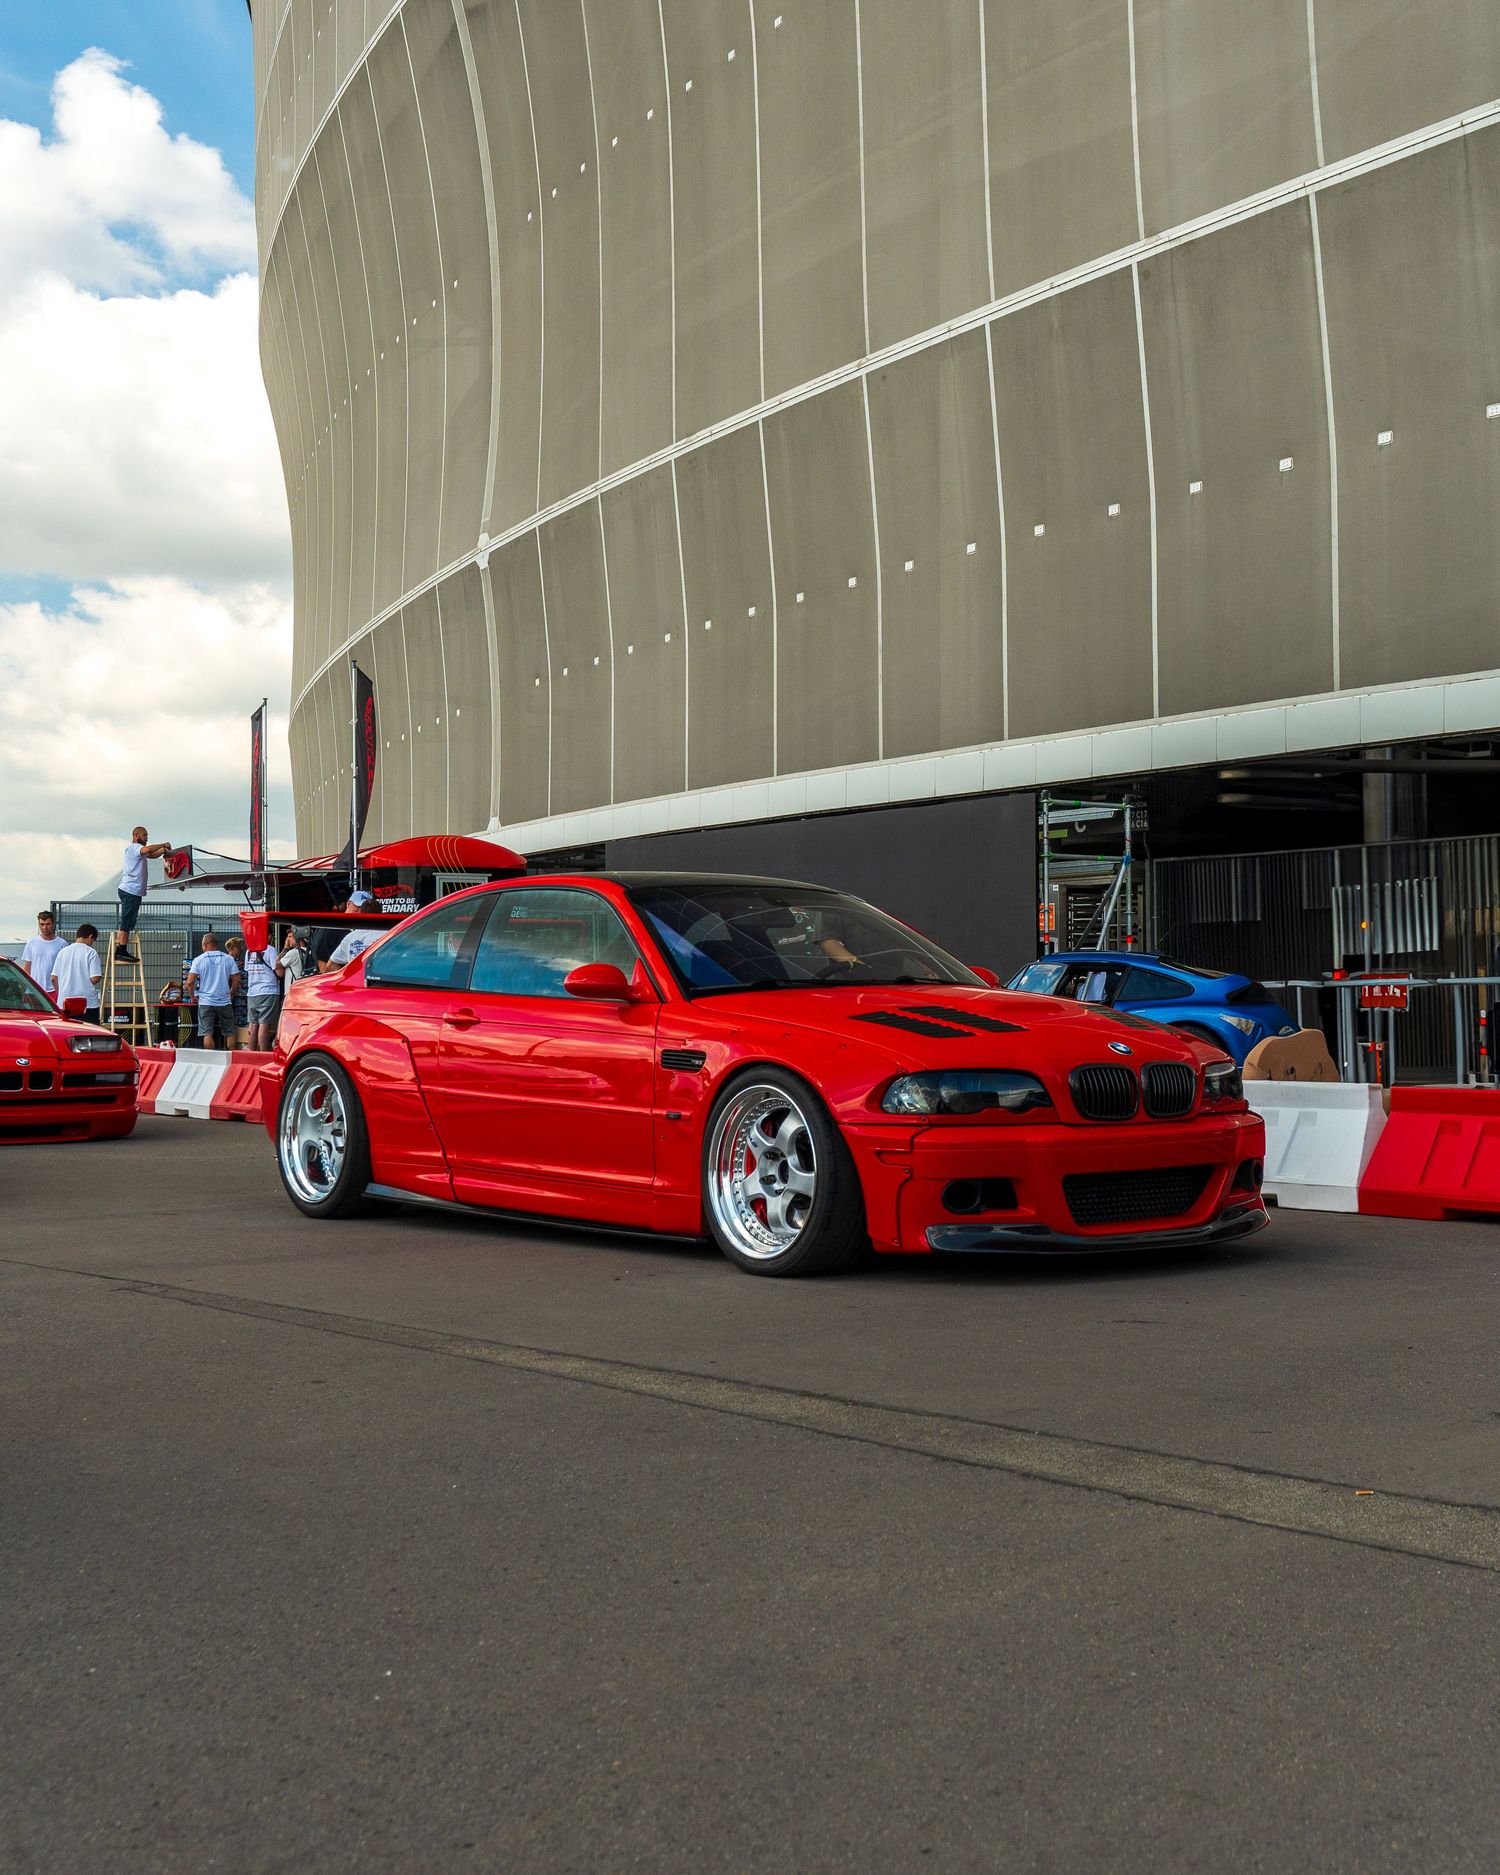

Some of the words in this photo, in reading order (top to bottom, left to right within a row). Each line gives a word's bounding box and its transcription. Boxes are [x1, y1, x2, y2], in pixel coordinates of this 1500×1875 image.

[1136, 810, 1148, 819] C17
[1136, 819, 1148, 828] C16
[381, 904, 420, 913] ENDARY
